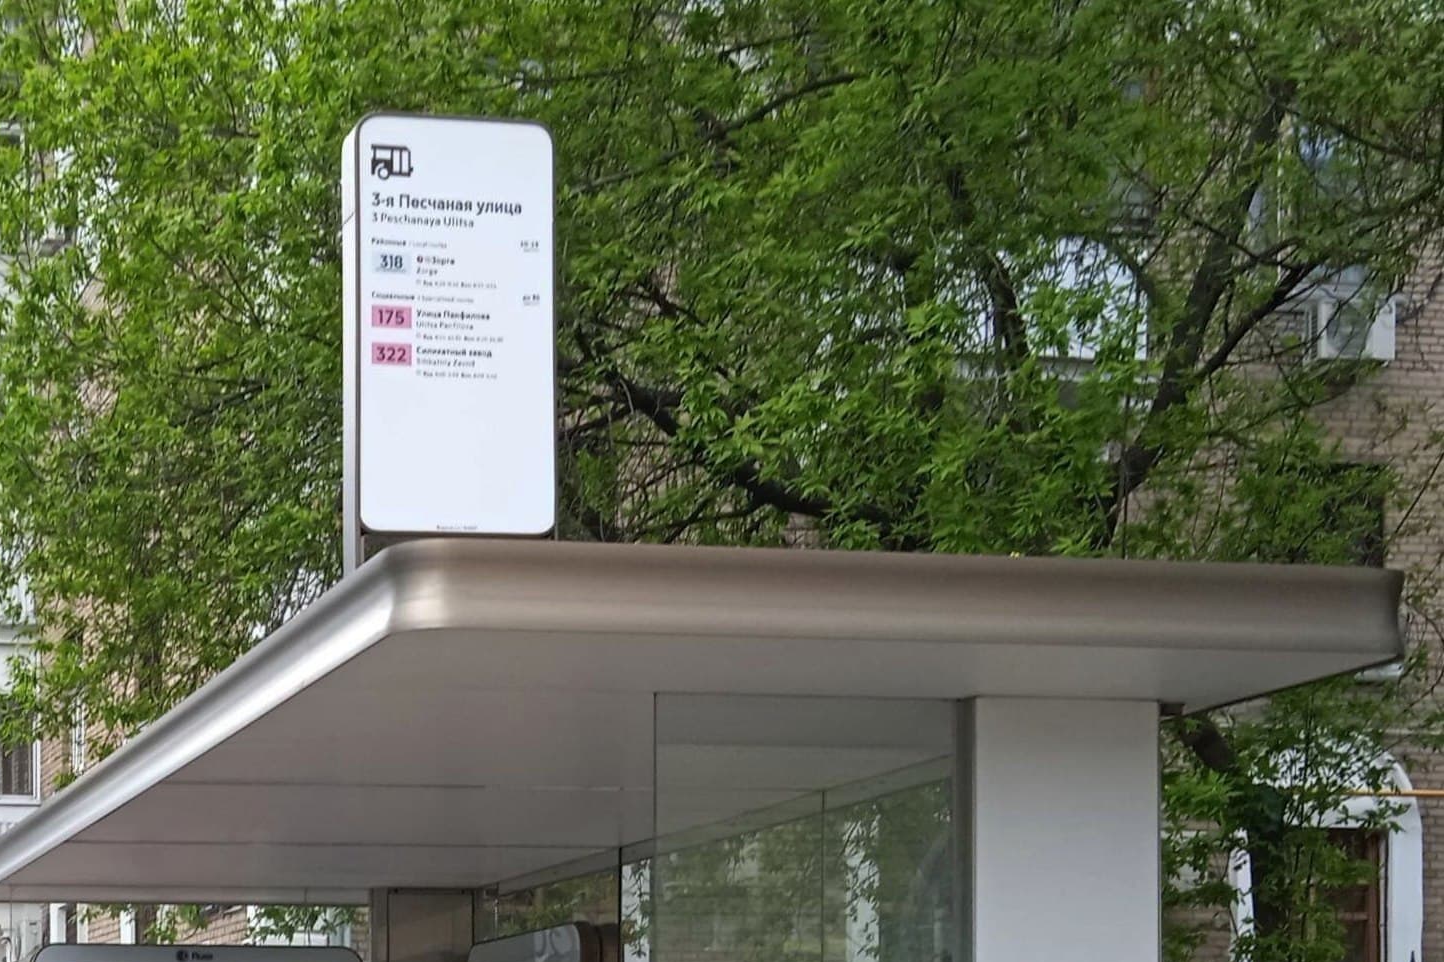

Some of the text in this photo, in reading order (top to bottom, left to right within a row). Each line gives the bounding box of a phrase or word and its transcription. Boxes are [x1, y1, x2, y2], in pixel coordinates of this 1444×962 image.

[371, 192, 522, 215] 3-я Песчаная улица
[371, 212, 474, 228] 3 Peschanaya Ulitsa
[380, 253, 403, 269] 318
[377, 310, 404, 325] 175
[376, 347, 406, 362] 322
